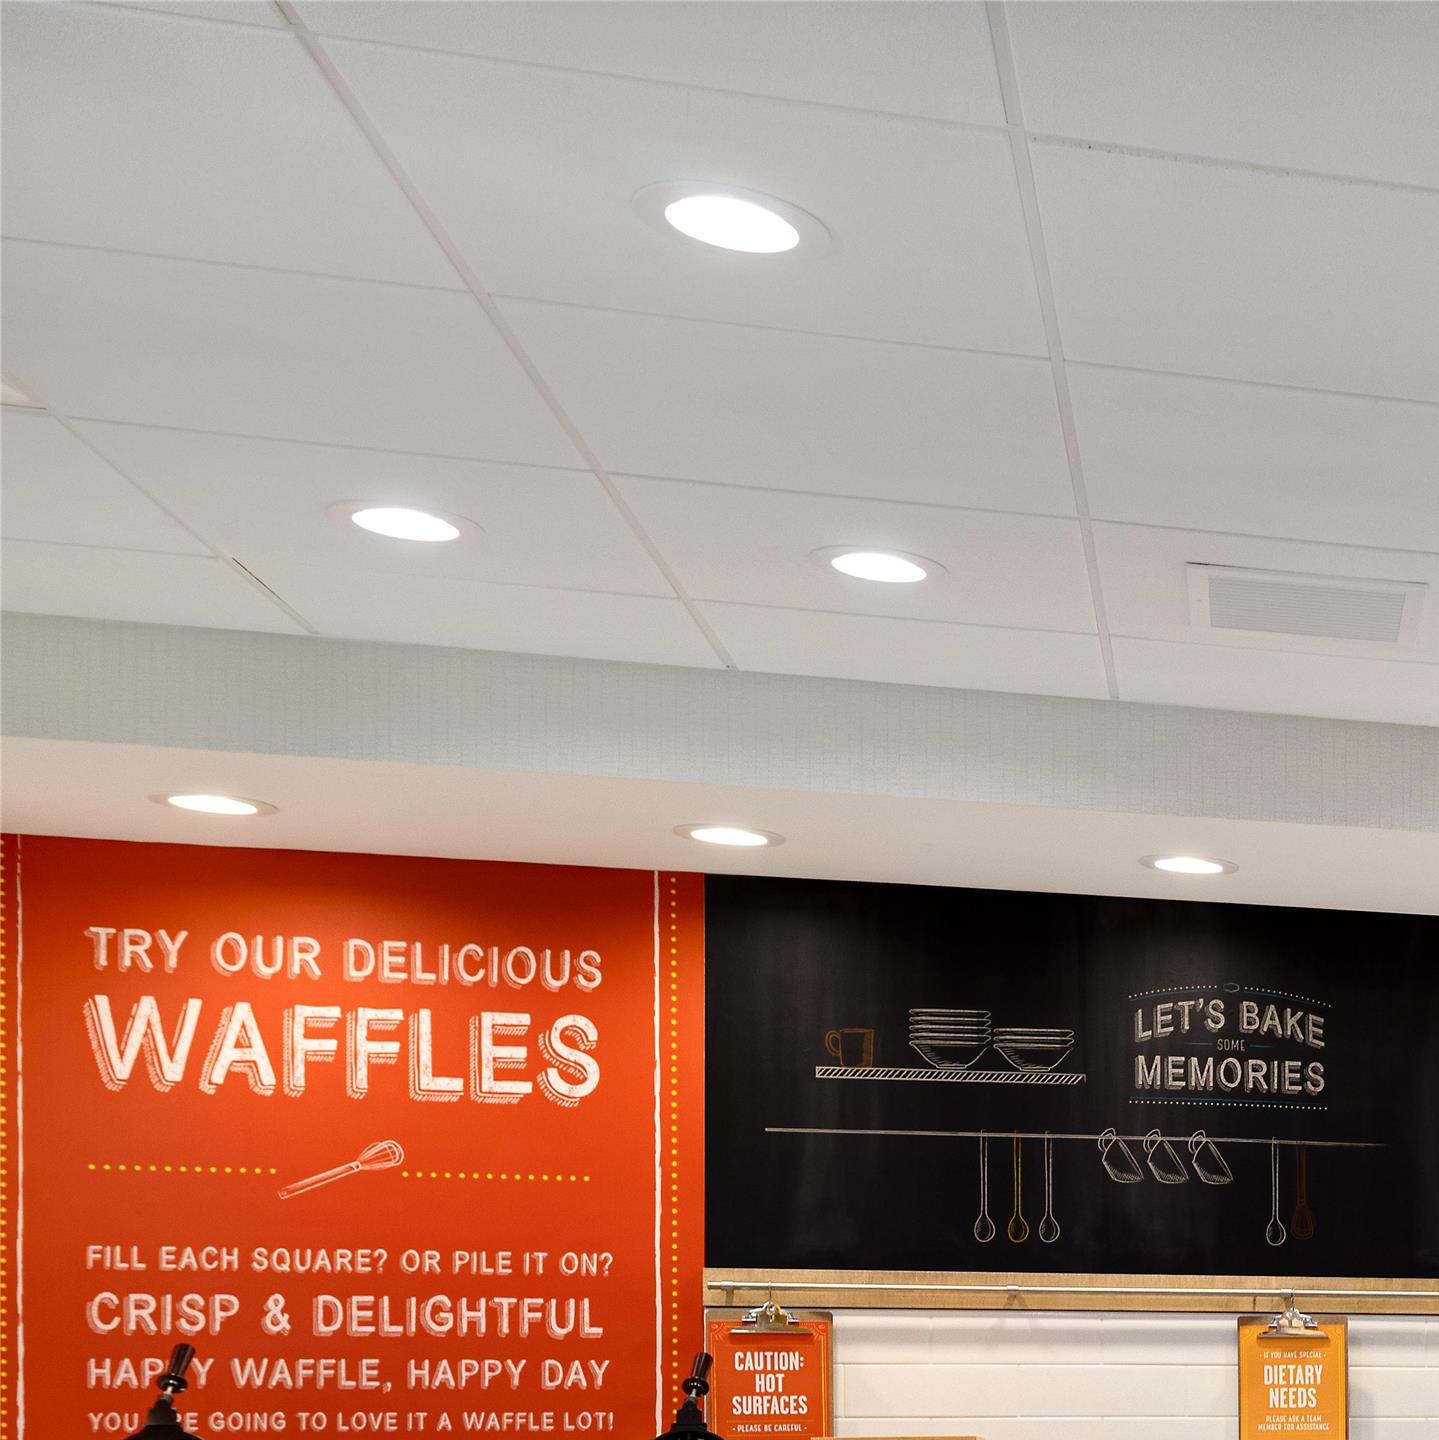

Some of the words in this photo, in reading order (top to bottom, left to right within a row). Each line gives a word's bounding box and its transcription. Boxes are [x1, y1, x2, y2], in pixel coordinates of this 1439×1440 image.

[84, 927, 188, 973] TRY
[210, 932, 322, 980] OUR
[343, 938, 602, 992] DELICIOUS
[1134, 999, 1226, 1042] LET'S
[1239, 1001, 1326, 1049] BAKE
[84, 995, 600, 1107] WAFFLES
[1217, 1039, 1246, 1051] SOME
[1135, 1055, 1326, 1094] MEMORIES
[86, 1245, 146, 1271] FILL
[159, 1246, 239, 1271] EACH
[251, 1247, 388, 1273] SQUARE?
[400, 1249, 441, 1274] OR
[453, 1251, 512, 1276] PILE
[523, 1252, 548, 1276] IT
[559, 1252, 614, 1277] ON?
[86, 1291, 240, 1336] CRISP
[262, 1293, 291, 1336] &
[313, 1294, 604, 1340] DELIGHTFUL
[734, 1352, 804, 1371] CAUTION:
[87, 1358, 215, 1389] HAPY
[231, 1358, 392, 1393] WAFFLE,
[407, 1359, 527, 1390] HAPPY
[541, 1359, 610, 1390] DAY
[755, 1373, 784, 1393] HOT
[1264, 1364, 1323, 1385] DIETARY
[732, 1395, 808, 1415] SURFACES
[1269, 1387, 1317, 1408] NEEDS
[89, 1412, 139, 1432] YOU
[208, 1411, 287, 1432] GOING
[296, 1412, 327, 1432] TO
[337, 1412, 398, 1432] LOVE
[407, 1412, 427, 1431] IT
[437, 1412, 452, 1431] A
[462, 1412, 554, 1431] WAFFLE
[563, 1411, 614, 1431] LOT!
[737, 1424, 761, 1432] PLEASE
[764, 1424, 772, 1432] BE
[774, 1423, 802, 1432] CAREFUL
